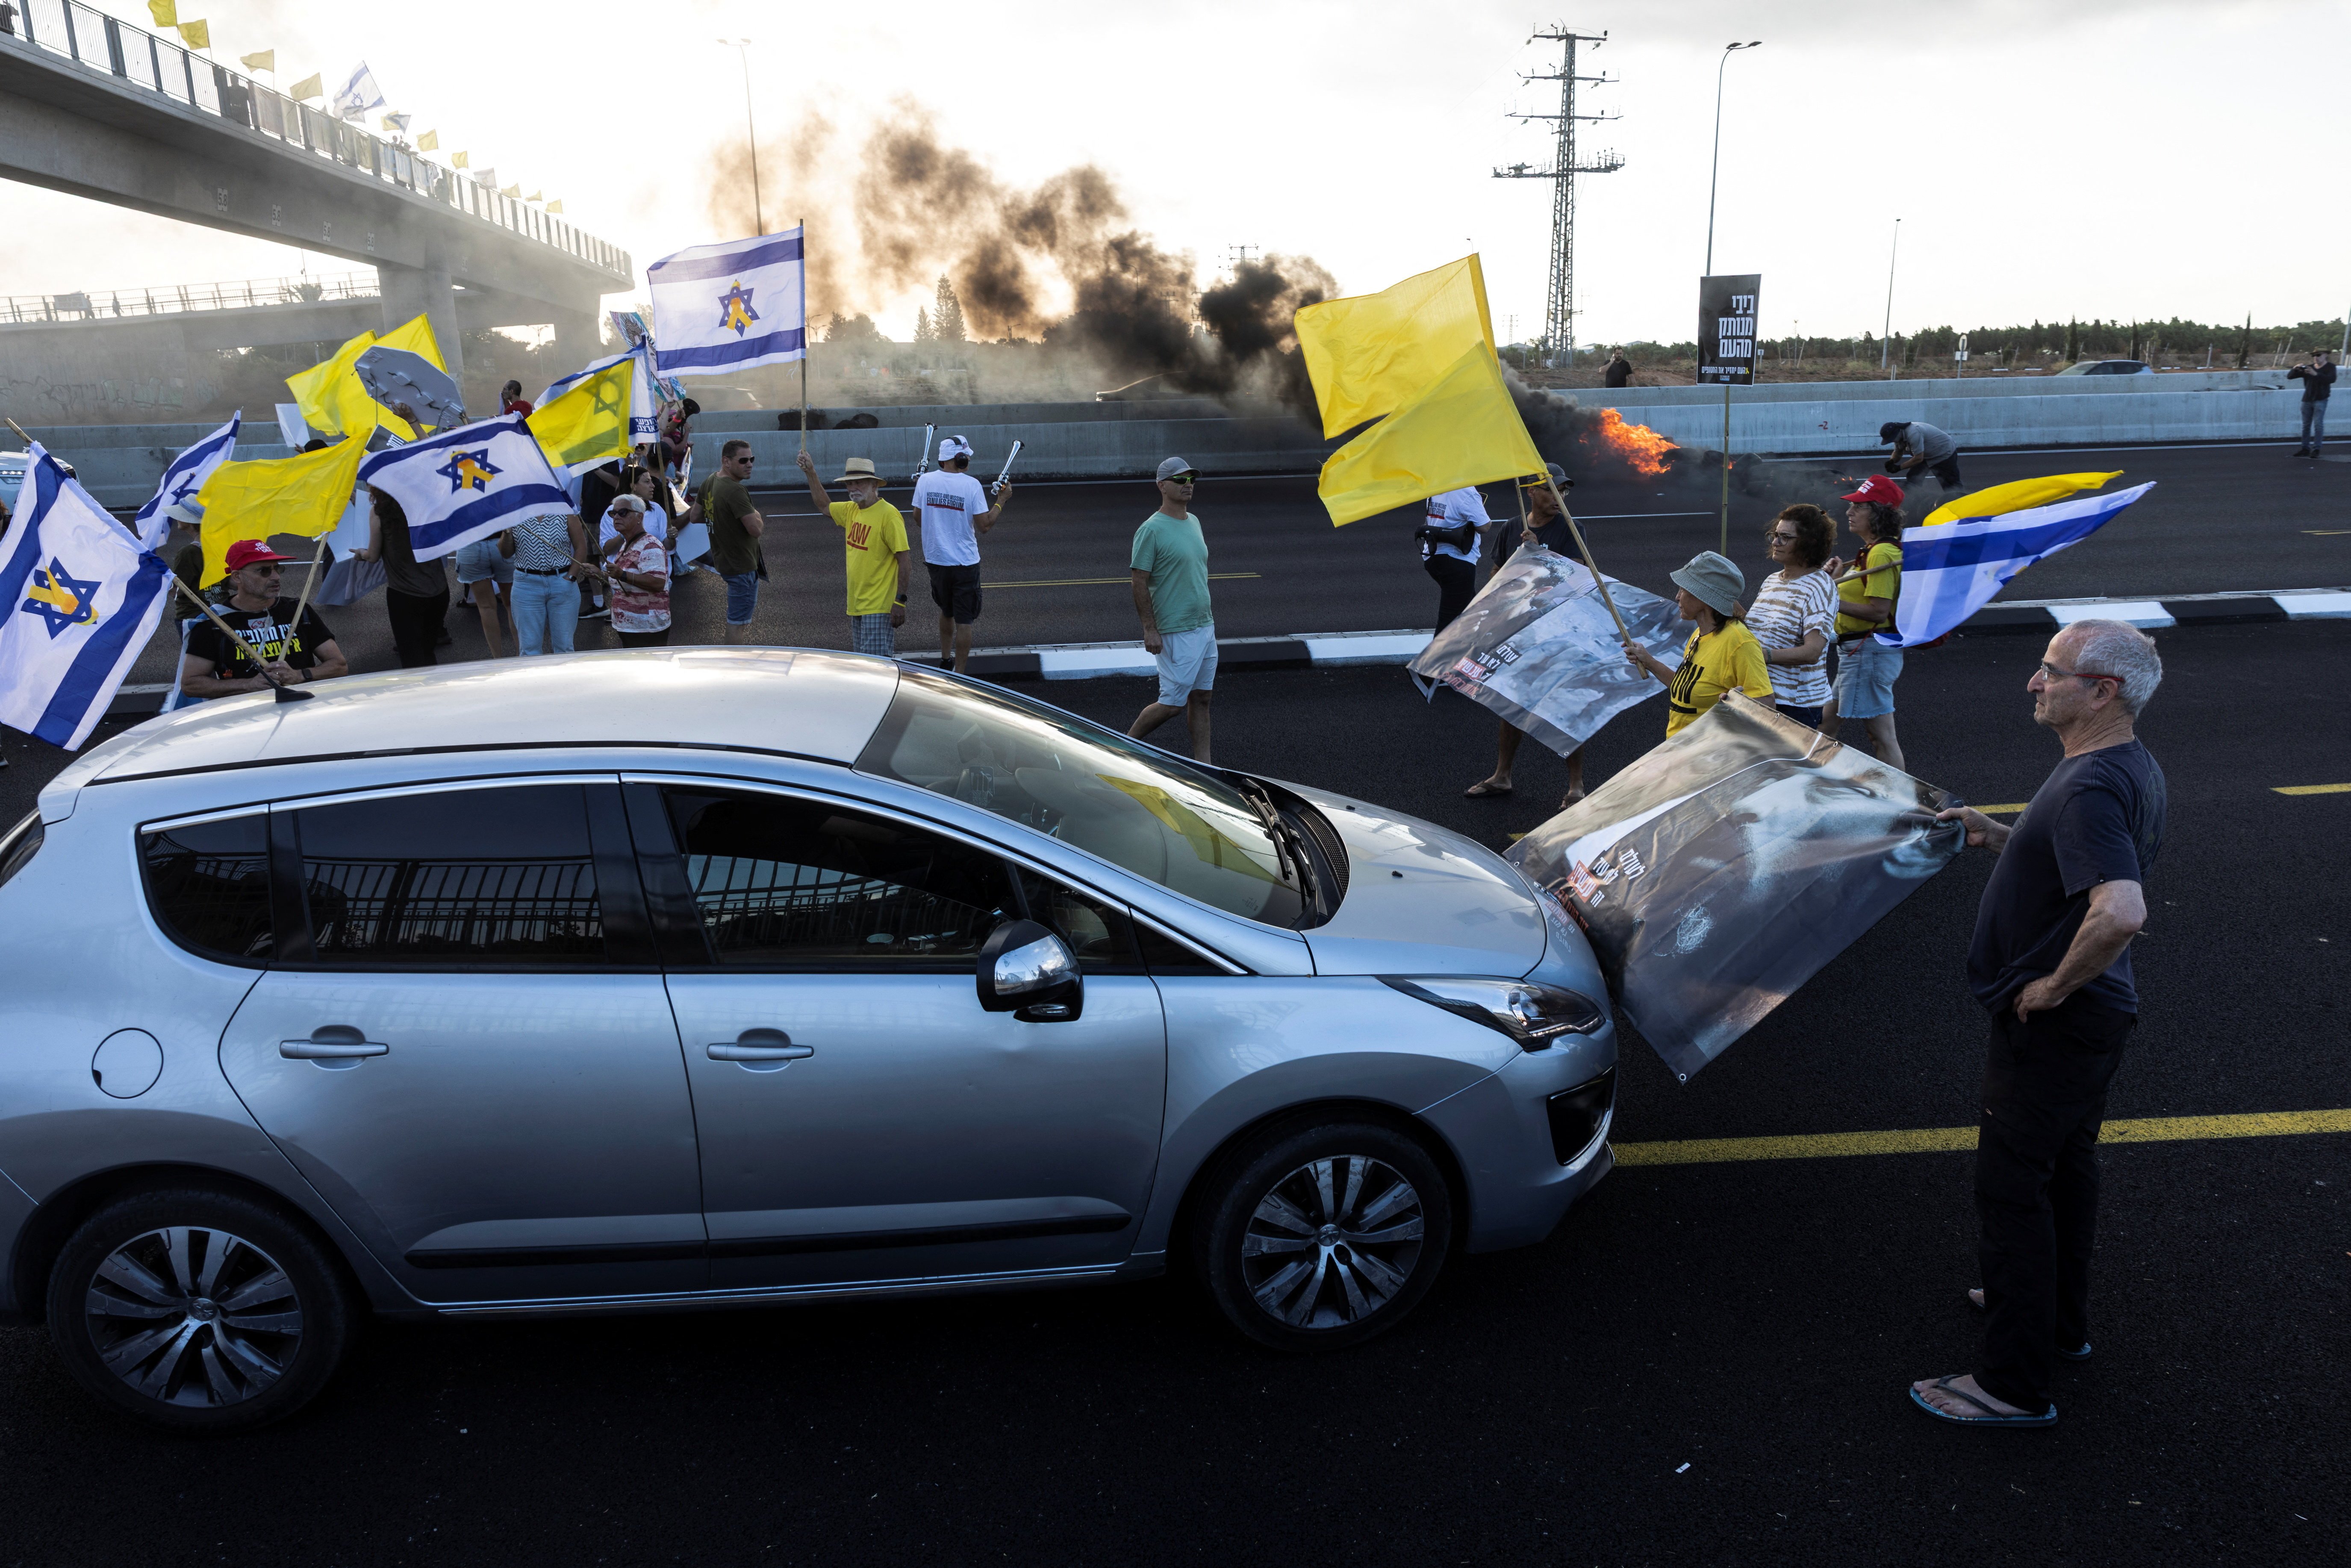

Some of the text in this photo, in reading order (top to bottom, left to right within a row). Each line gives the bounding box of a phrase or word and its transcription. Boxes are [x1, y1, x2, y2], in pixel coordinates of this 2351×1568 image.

[218, 193, 227, 206] 5.8
[272, 209, 280, 222] 5.8
[1732, 295, 1754, 314] ביבי
[1718, 317, 1753, 339] מנותק
[1719, 339, 1752, 357] מהעם
[635, 418, 657, 426] חופשי
[636, 424, 659, 432] בארצנו
[927, 497, 964, 509] FAMILIES FORUM
[1487, 658, 1501, 669] לא
[1593, 857, 1619, 885] לא עוד
[1619, 848, 1646, 880] לעולם
[1570, 863, 1605, 908] זה עכשיו!
